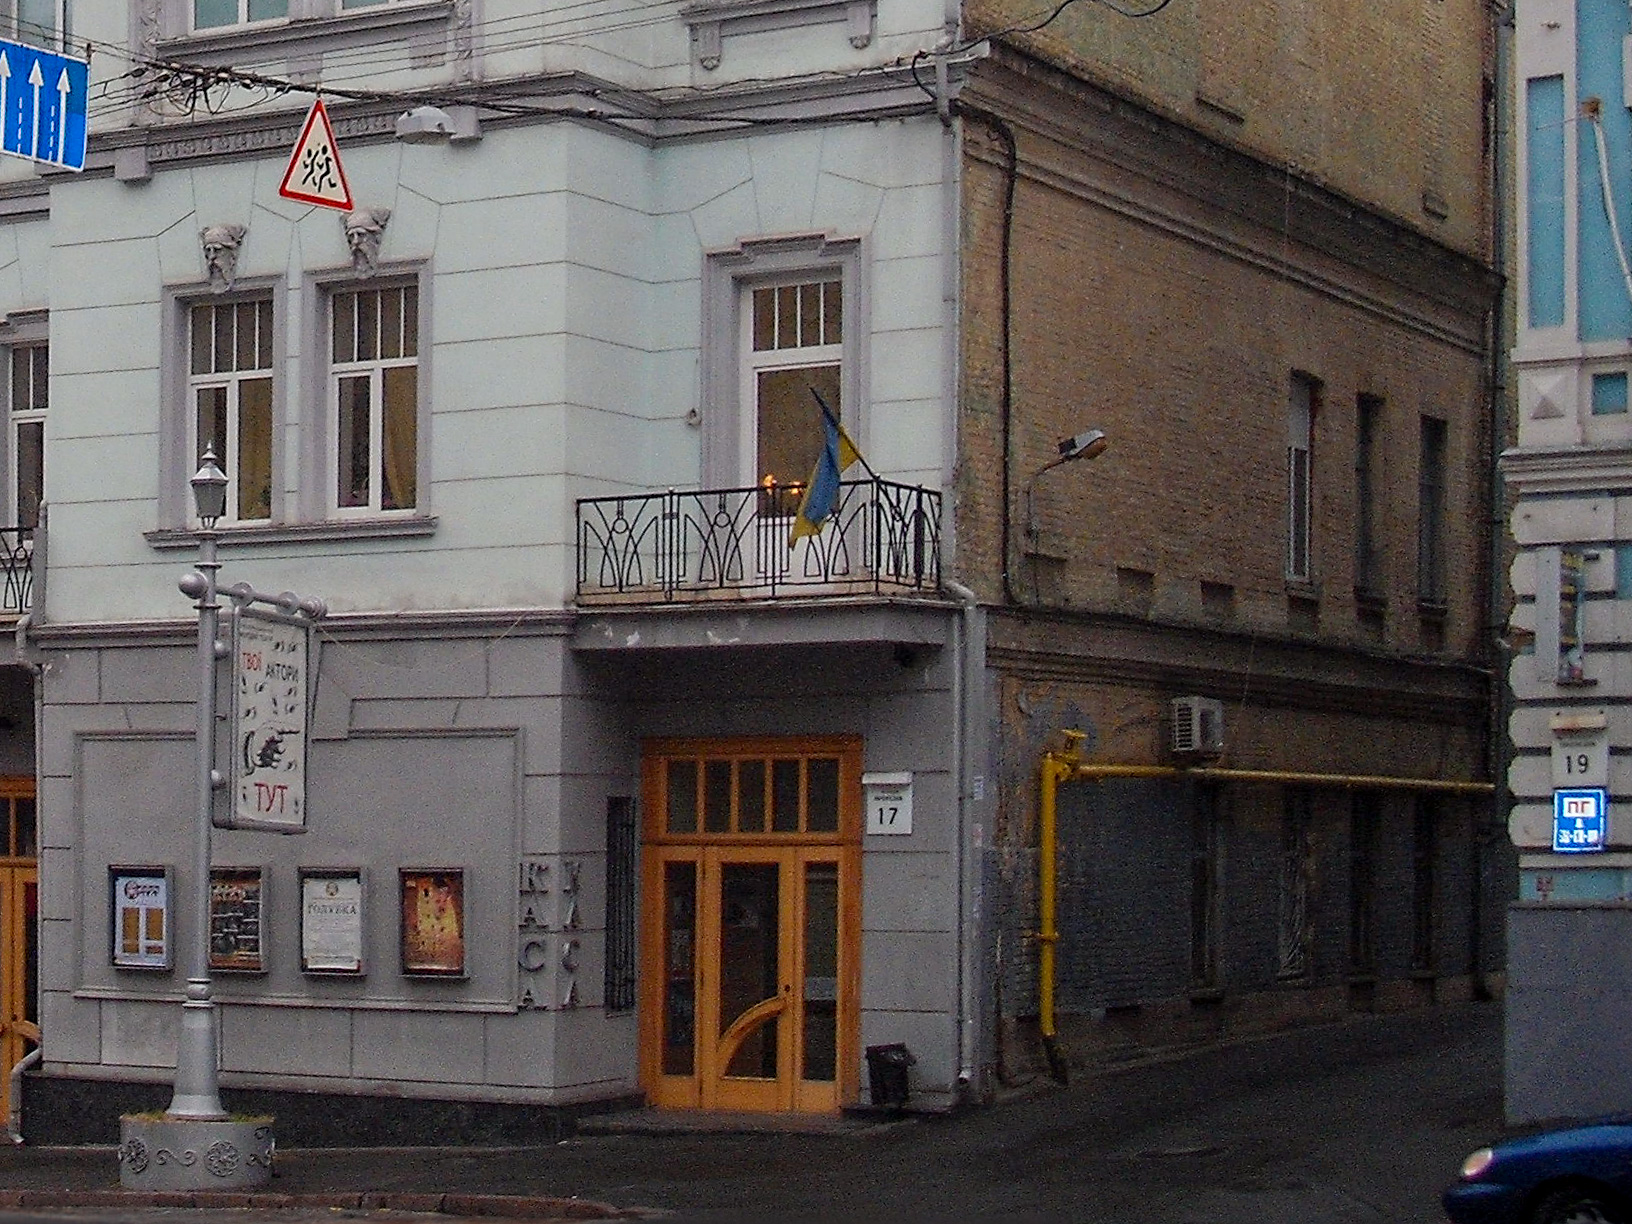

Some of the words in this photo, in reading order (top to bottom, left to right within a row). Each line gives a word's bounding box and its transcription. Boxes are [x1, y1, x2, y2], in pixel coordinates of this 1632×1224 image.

[1566, 754, 1589, 774] 19
[254, 782, 288, 814] ТУТ
[1568, 801, 1590, 813] ПГ
[878, 807, 898, 825] 17
[519, 862, 549, 1011] КАСА
